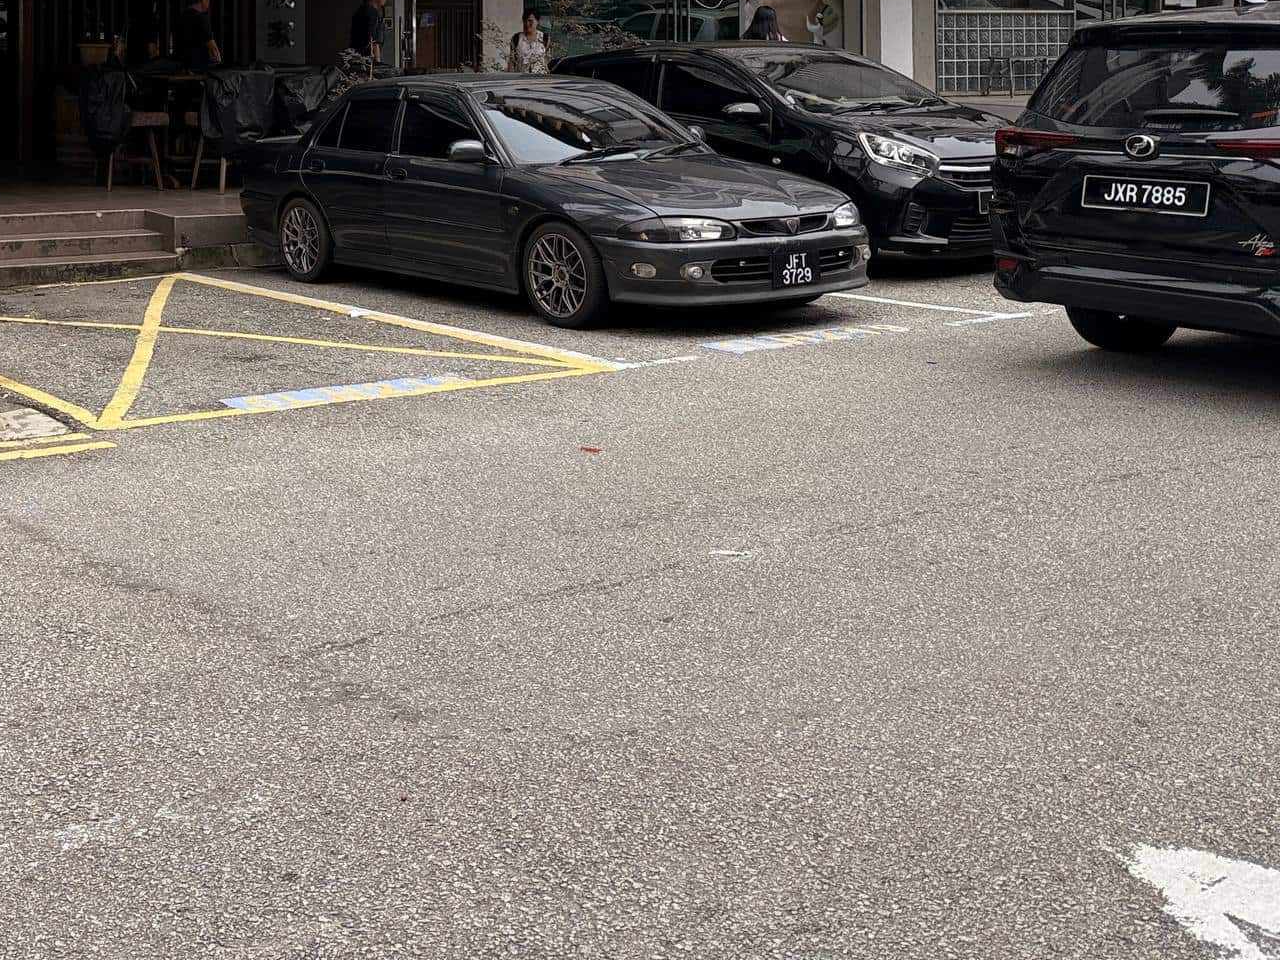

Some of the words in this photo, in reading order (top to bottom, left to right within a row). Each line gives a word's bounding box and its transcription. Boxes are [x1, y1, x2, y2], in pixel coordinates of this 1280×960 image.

[1103, 183, 1138, 203] JXR
[1141, 184, 1186, 206] 7885
[785, 252, 808, 269] JFT
[782, 267, 812, 285] 3729
